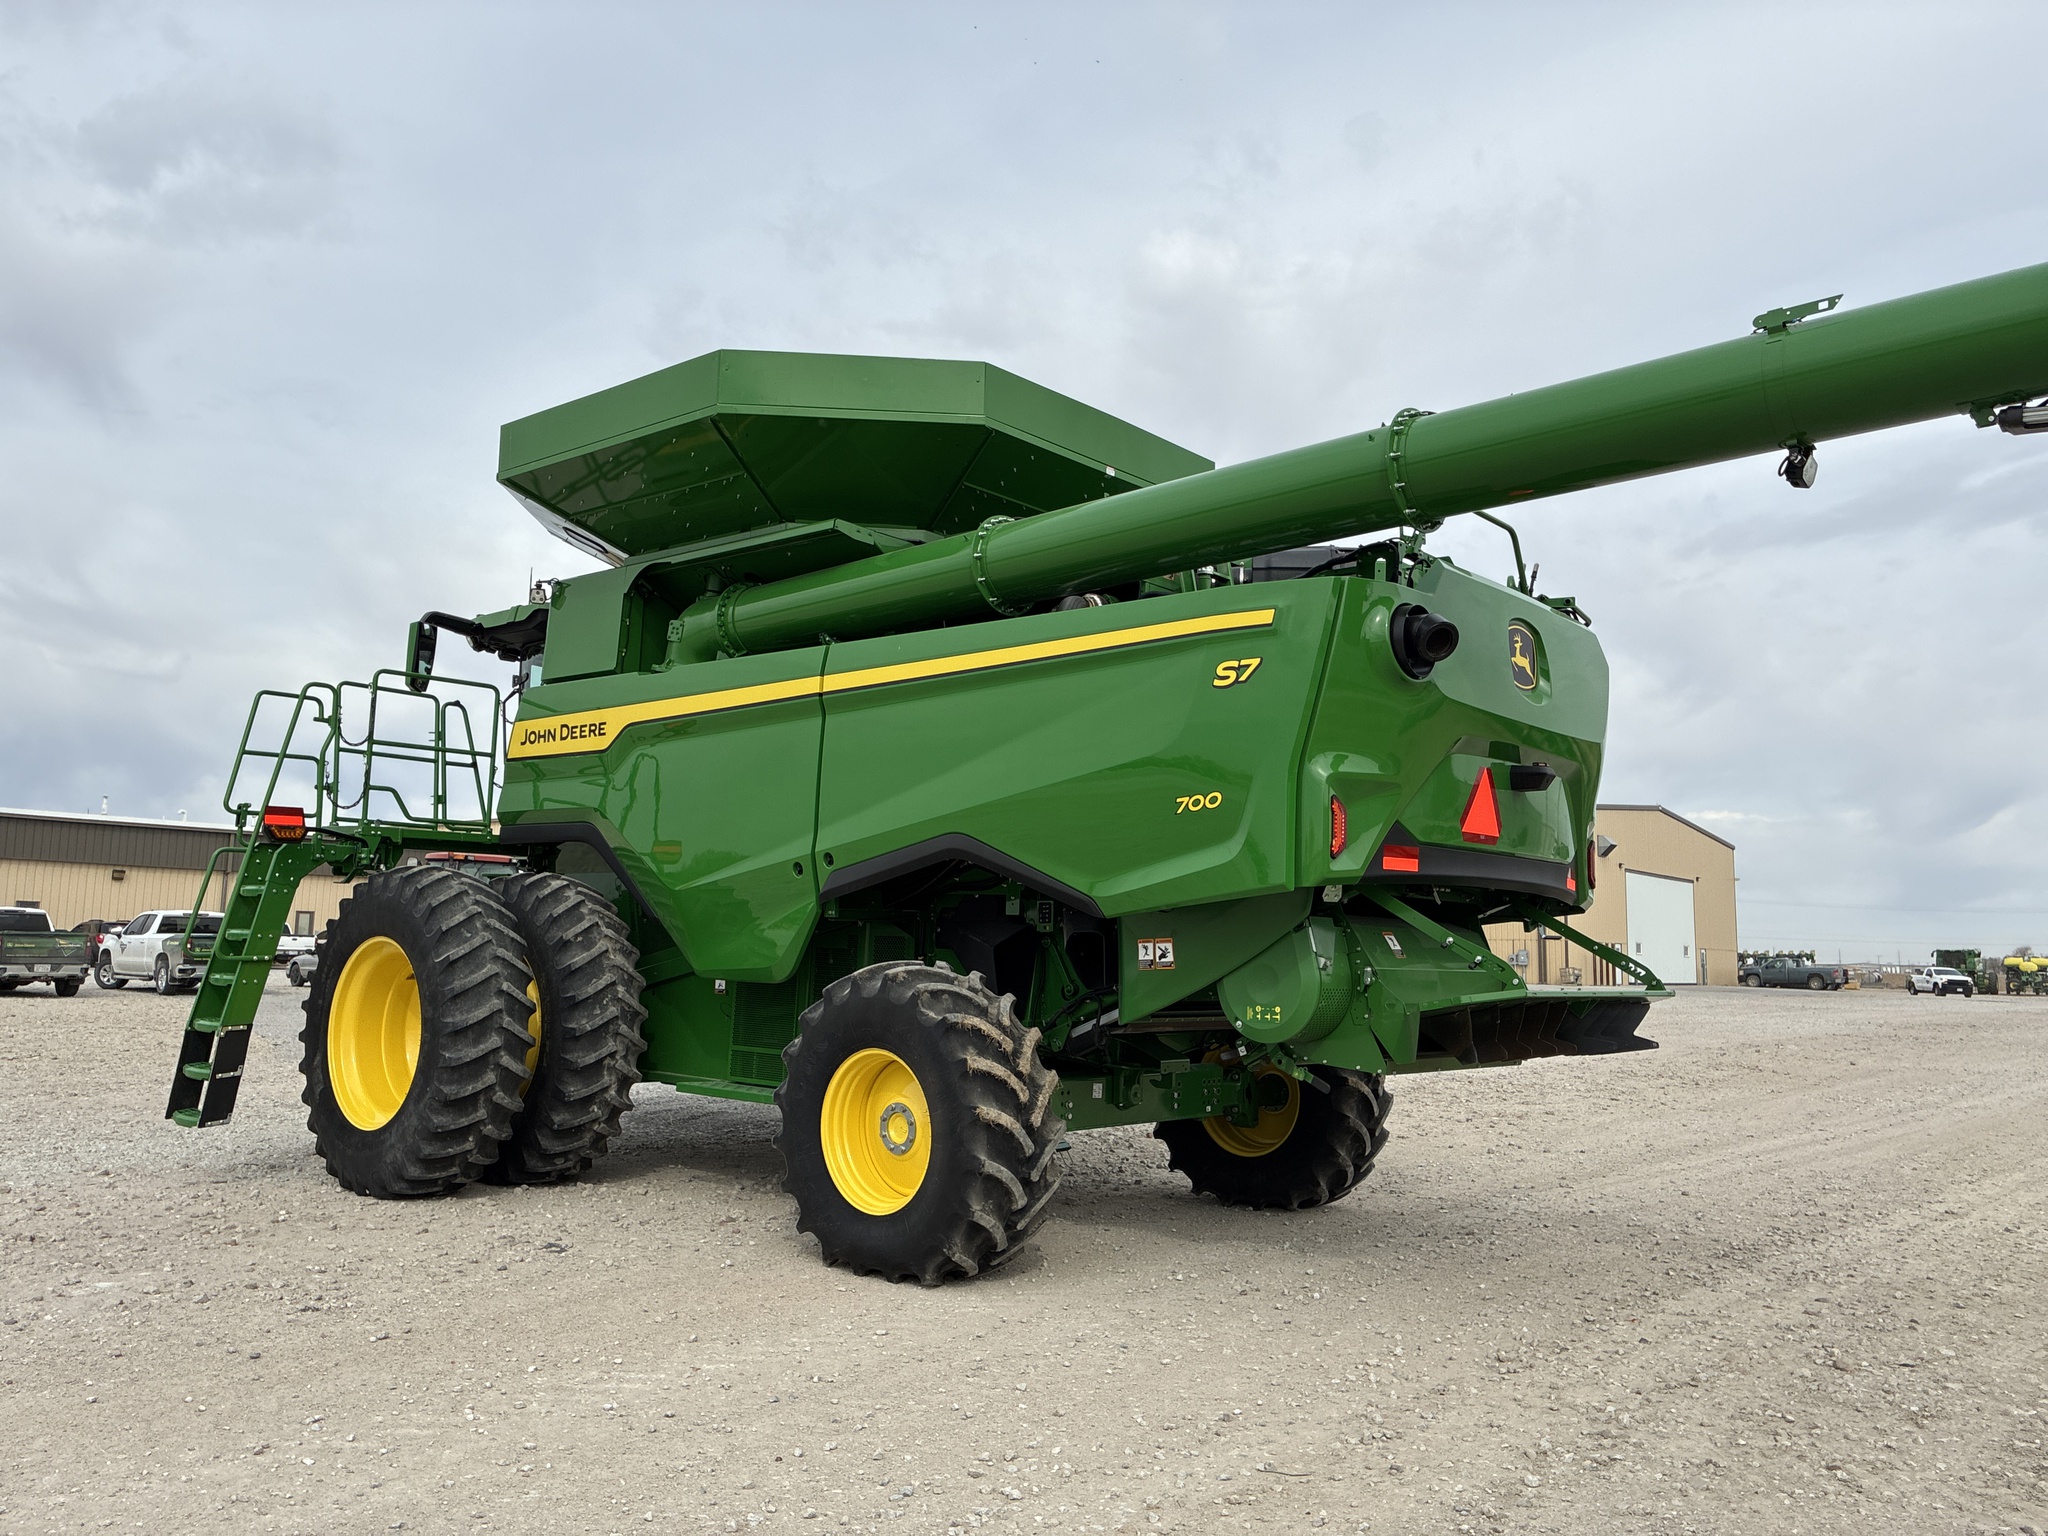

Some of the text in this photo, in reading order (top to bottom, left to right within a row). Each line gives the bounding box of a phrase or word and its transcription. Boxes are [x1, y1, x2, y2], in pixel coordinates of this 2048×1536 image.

[1212, 656, 1263, 689] S7
[520, 721, 607, 746] JOHN DEERE
[1175, 790, 1223, 815] 700
